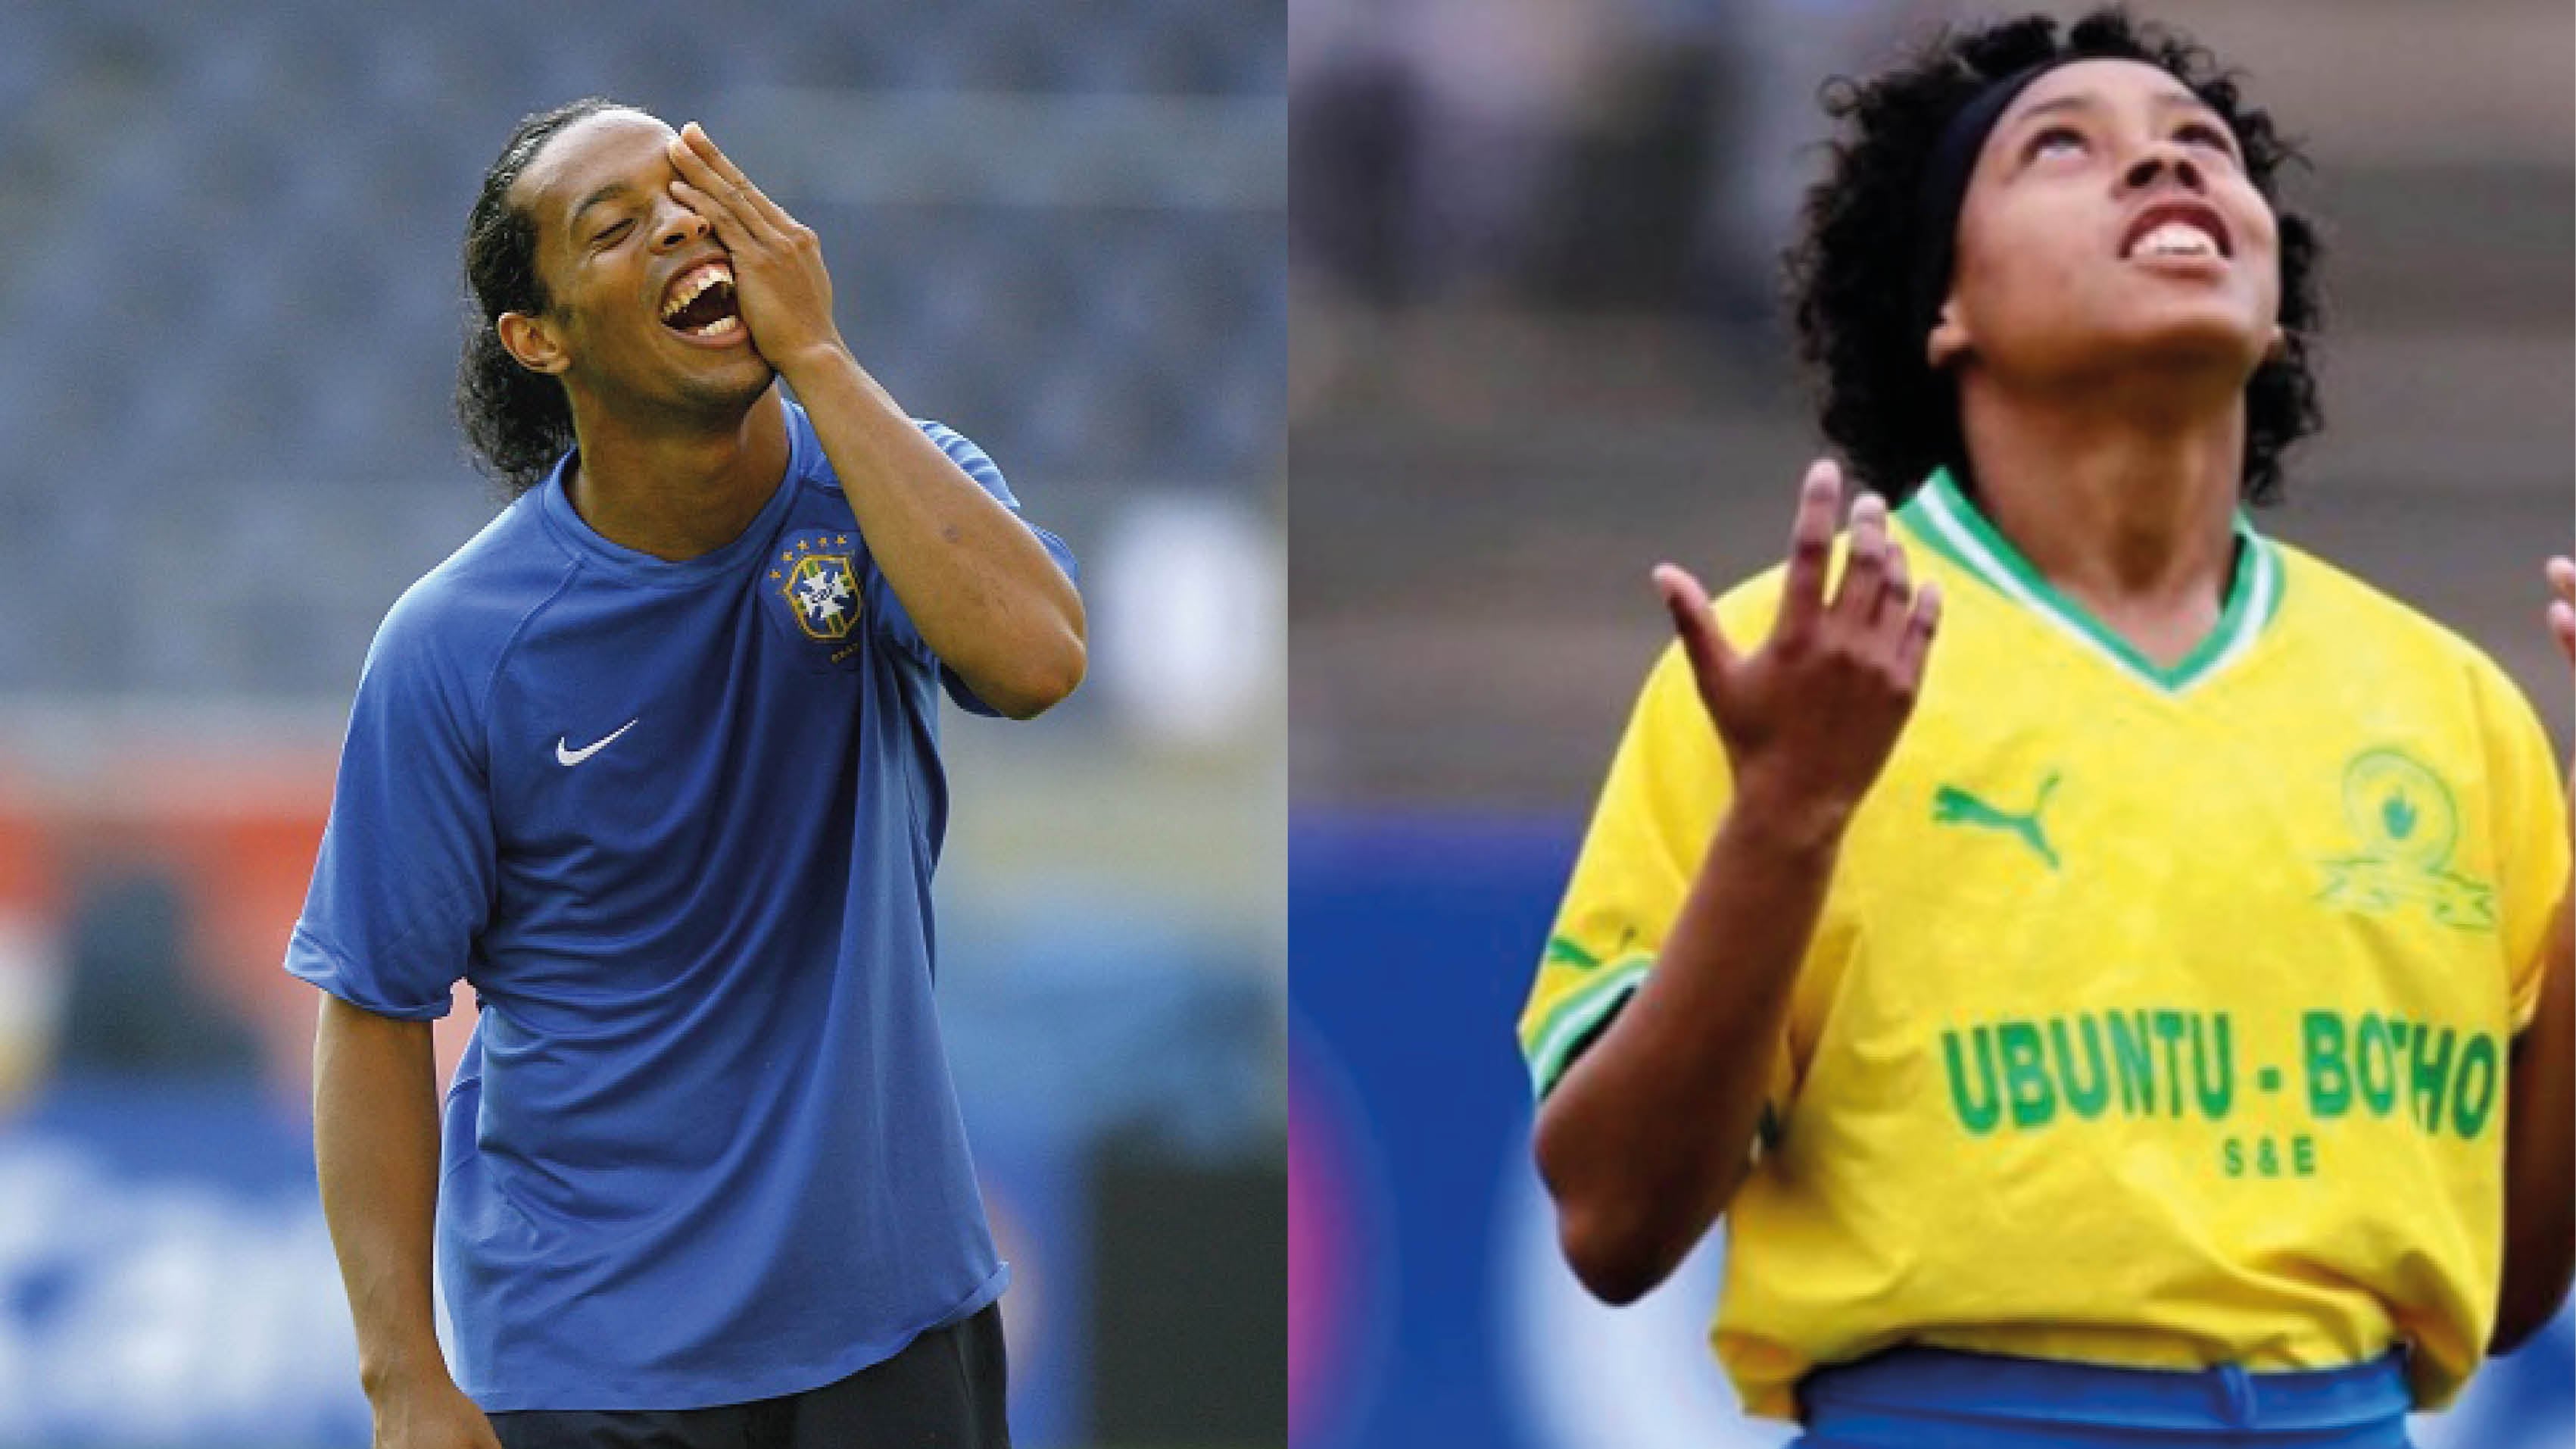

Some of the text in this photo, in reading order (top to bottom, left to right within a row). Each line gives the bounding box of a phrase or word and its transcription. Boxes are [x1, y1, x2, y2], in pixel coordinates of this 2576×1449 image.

[1941, 1009, 2235, 1135] UBUNTU
[2224, 1138, 2243, 1176] S
[2292, 1135, 2315, 1175] E
